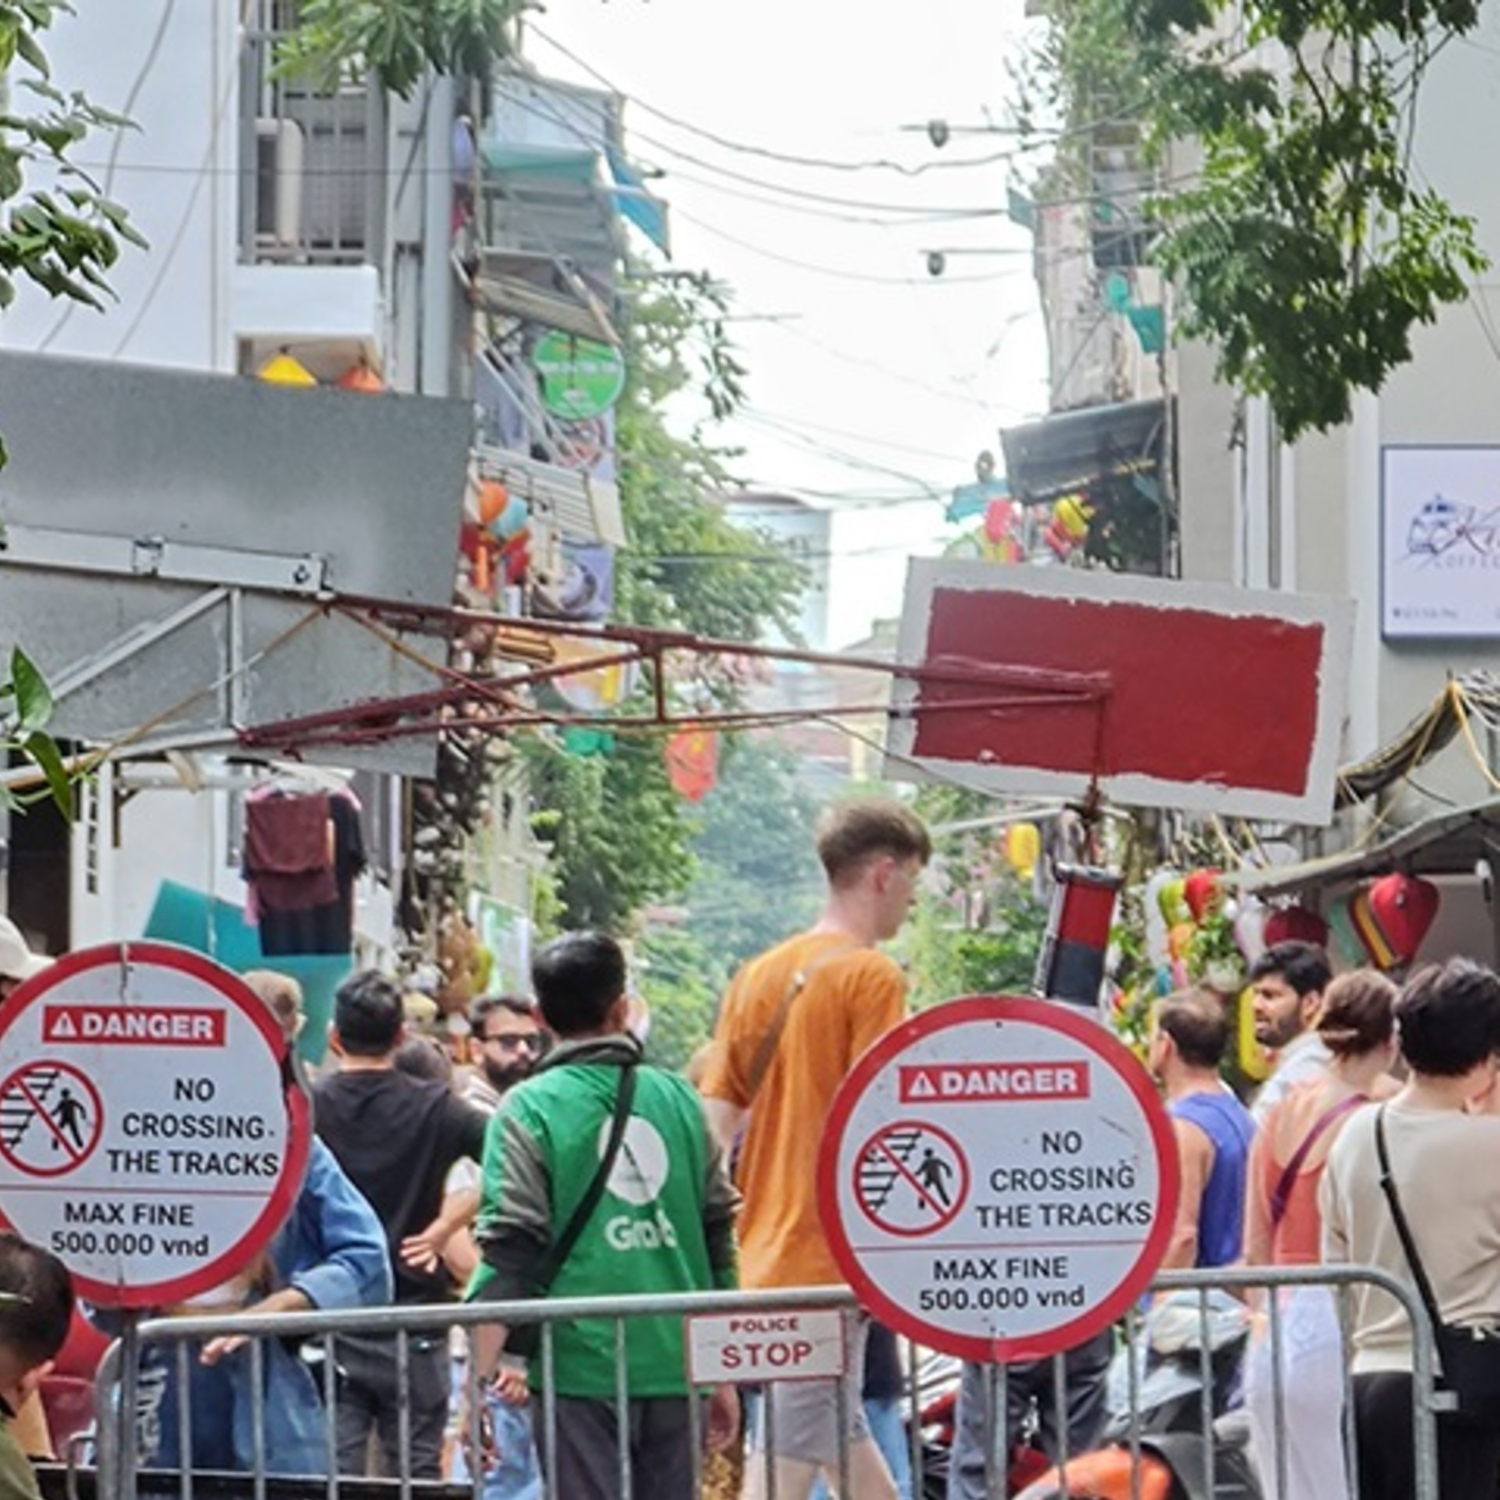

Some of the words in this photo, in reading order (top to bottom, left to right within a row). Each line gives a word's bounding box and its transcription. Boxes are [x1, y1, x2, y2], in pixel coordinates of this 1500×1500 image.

[82, 1013, 215, 1040] DANGER
[174, 1077, 216, 1102] NO
[941, 1067, 1078, 1095] DANGER
[121, 1112, 265, 1140] CROSSING
[1041, 1130, 1083, 1155] NO
[107, 1149, 160, 1174] THE
[169, 1151, 280, 1177] TRACKS
[989, 1165, 1135, 1193] CROSSING
[63, 1202, 125, 1226] MAX
[132, 1203, 194, 1227] FINE
[975, 1204, 1032, 1229] THE
[1039, 1201, 1153, 1227] TRACKS
[51, 1231, 154, 1255] 500.000
[161, 1234, 210, 1257] vnd
[932, 1258, 998, 1282] MAX
[1005, 1256, 1069, 1280] FINE
[919, 1286, 1029, 1312] 500.000
[1036, 1285, 1085, 1308] vnd
[729, 1317, 800, 1333] POLICE
[720, 1340, 813, 1370] STOP
